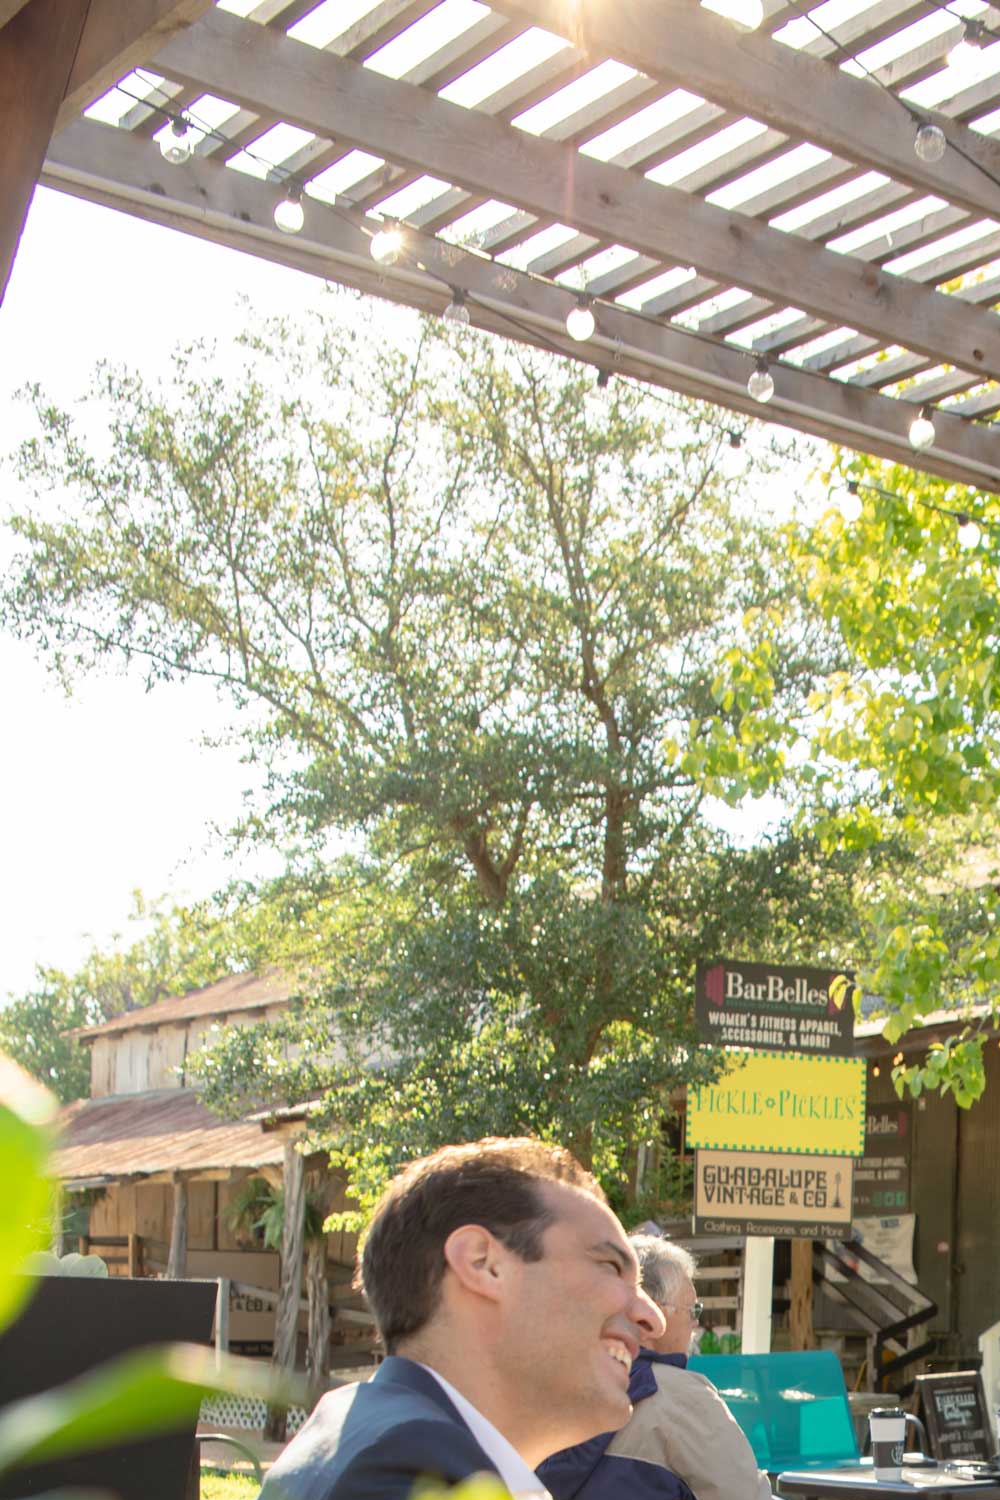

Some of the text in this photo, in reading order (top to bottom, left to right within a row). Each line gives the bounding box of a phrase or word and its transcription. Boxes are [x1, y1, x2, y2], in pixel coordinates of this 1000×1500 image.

[725, 971, 829, 1007] BarBelles
[708, 1011, 842, 1037] WOMEN'S FITNESS APPAREL,
[720, 1027, 831, 1048] ACCESSORIES, & MORE!
[779, 1088, 857, 1121] PICKLES
[703, 1164, 828, 1190] GUADALUPE
[704, 1185, 828, 1208] VINTAGE & CO
[800, 1224, 818, 1236] and
[821, 1224, 844, 1237] More
